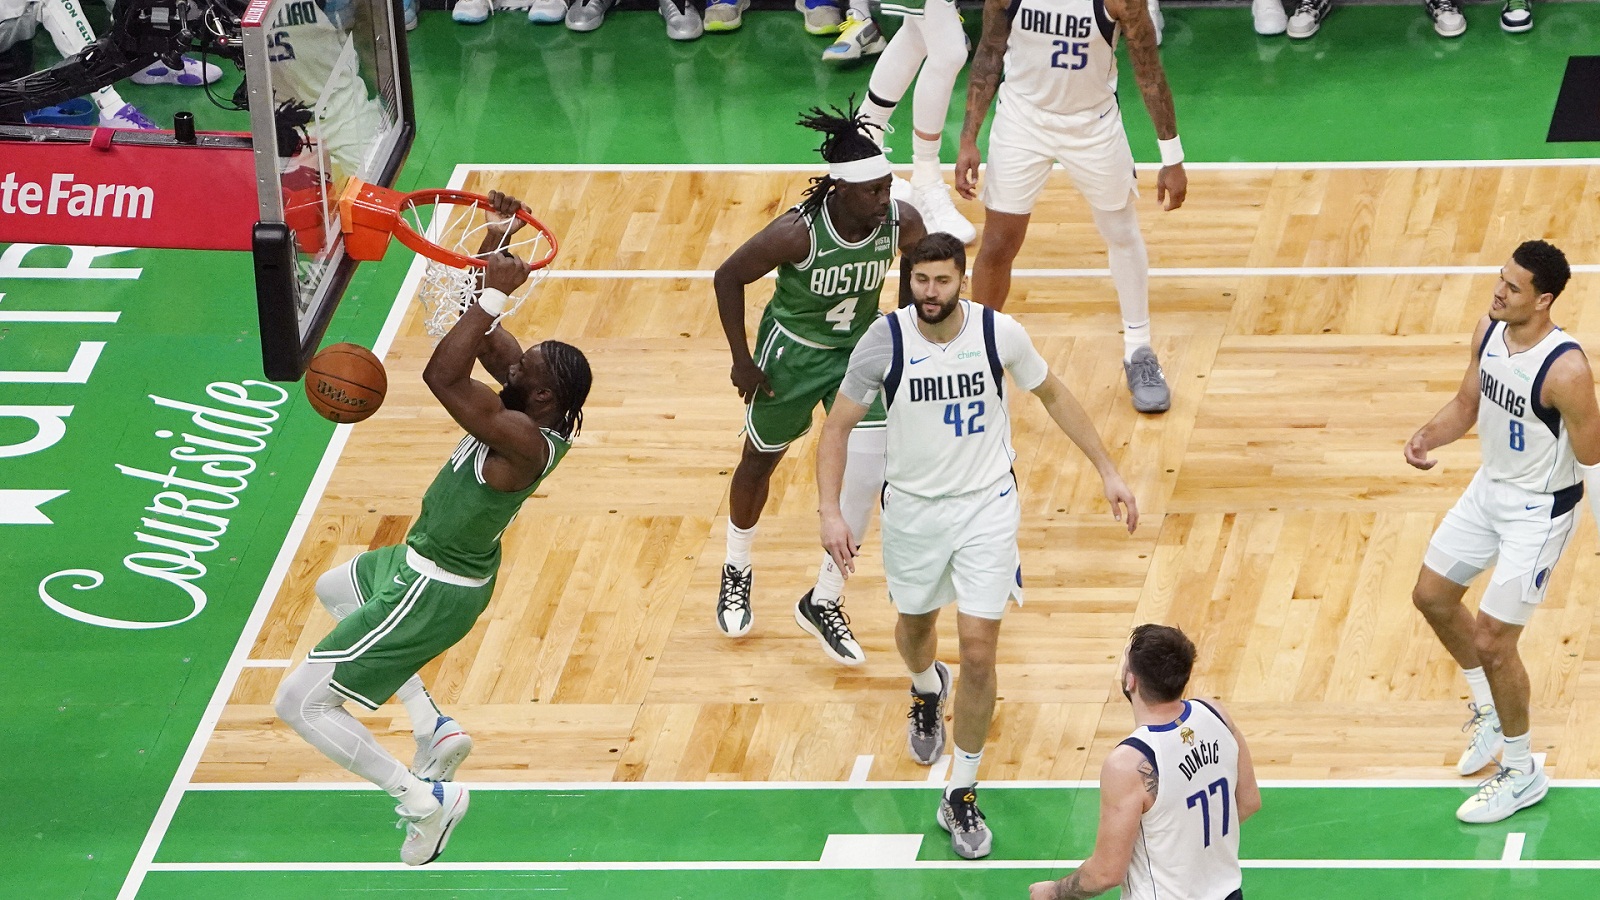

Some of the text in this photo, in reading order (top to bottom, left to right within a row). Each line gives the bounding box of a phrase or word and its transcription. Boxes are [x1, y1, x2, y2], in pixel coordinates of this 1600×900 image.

[1020, 8, 1092, 38] DALLAS
[1051, 39, 1089, 70] 25
[810, 259, 890, 297] BOSTON
[825, 297, 860, 331] 4
[957, 350, 982, 360] chime
[909, 371, 985, 403] DALLAS
[1480, 367, 1526, 418] DALLAS
[943, 400, 985, 437] 42
[1509, 419, 1525, 452] 8
[38, 379, 289, 630] Courtside
[1178, 739, 1220, 781] DONČIĆ
[1186, 776, 1230, 849] 77
